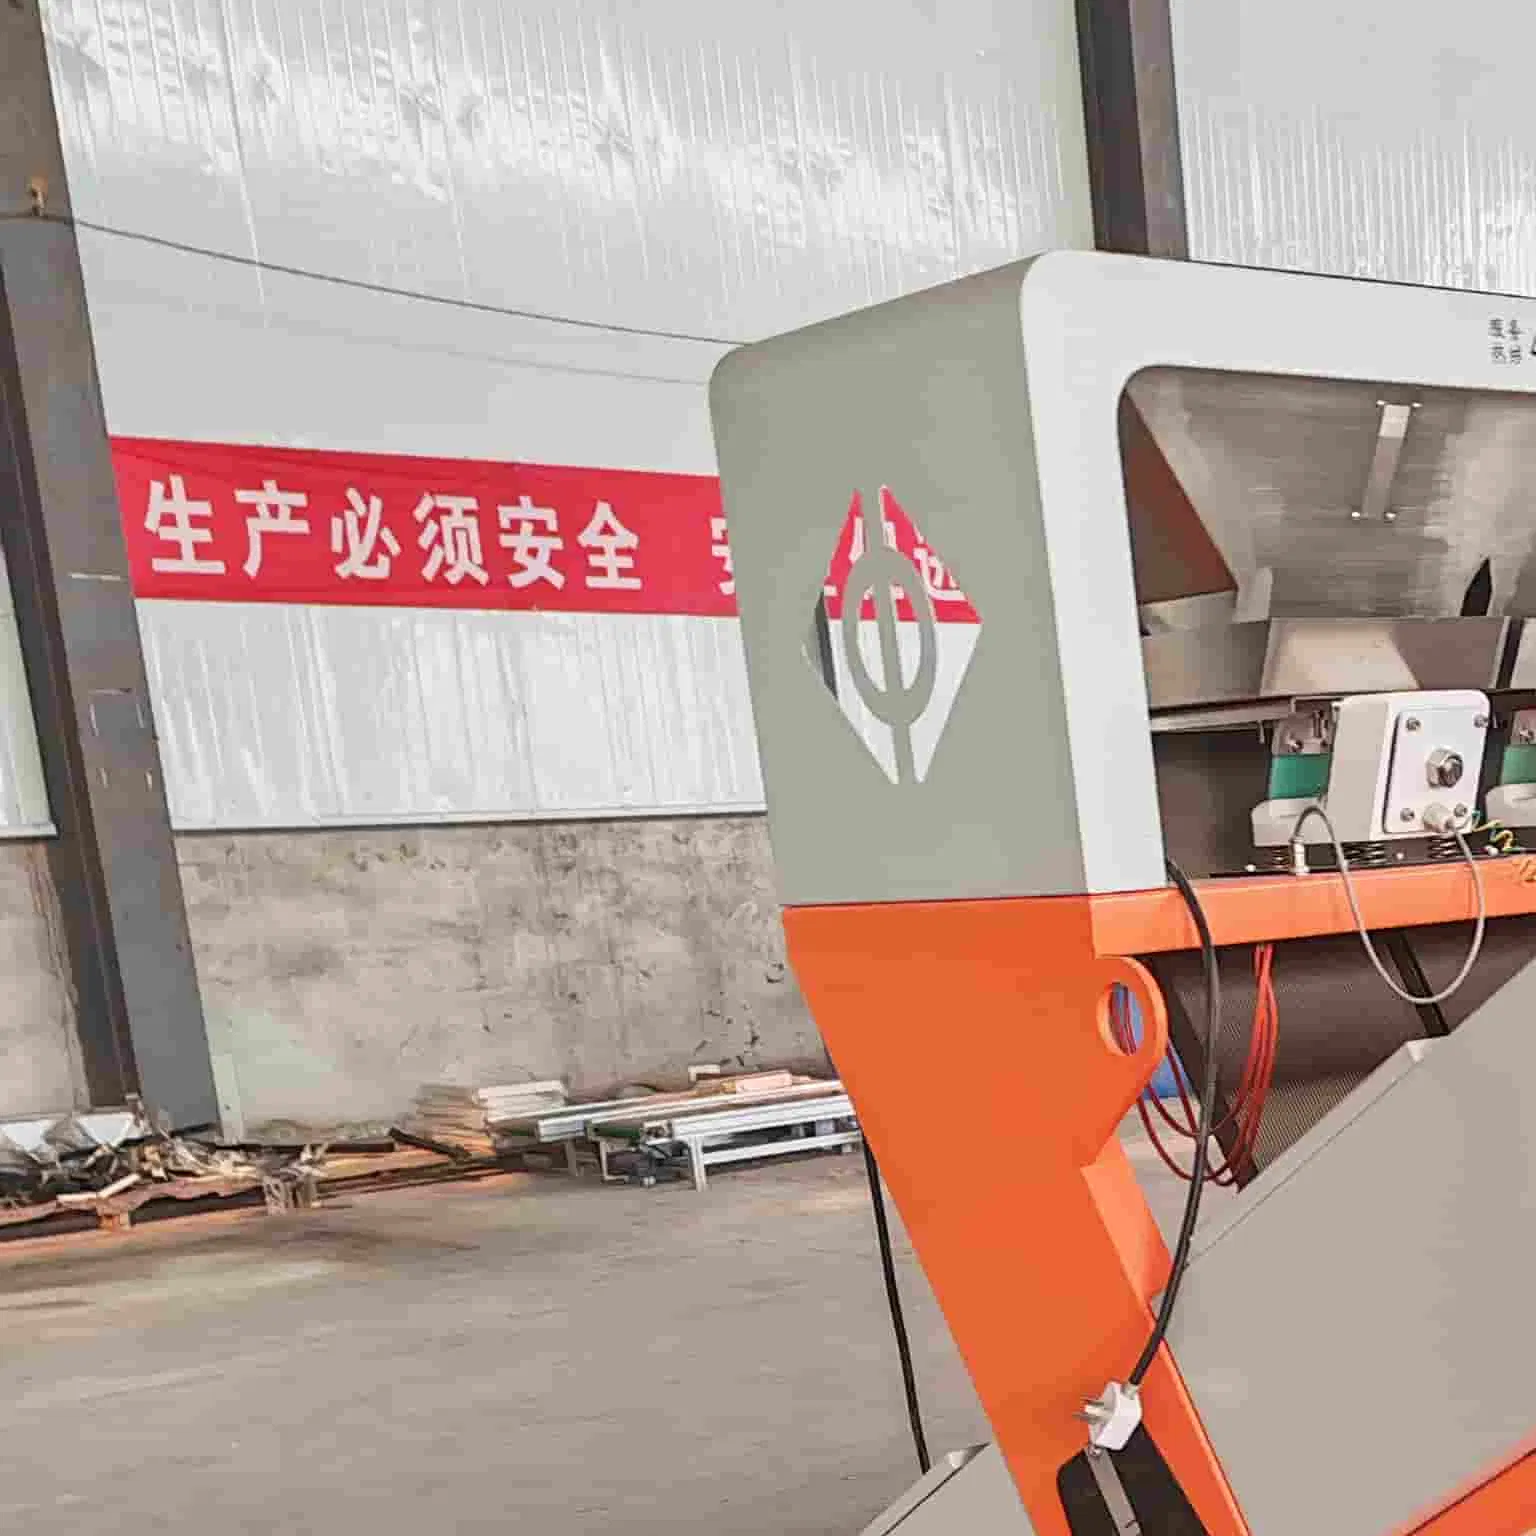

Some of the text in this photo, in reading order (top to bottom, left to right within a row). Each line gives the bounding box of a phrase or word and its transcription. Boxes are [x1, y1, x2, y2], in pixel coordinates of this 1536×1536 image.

[144, 475, 643, 591] 生产必须安全
